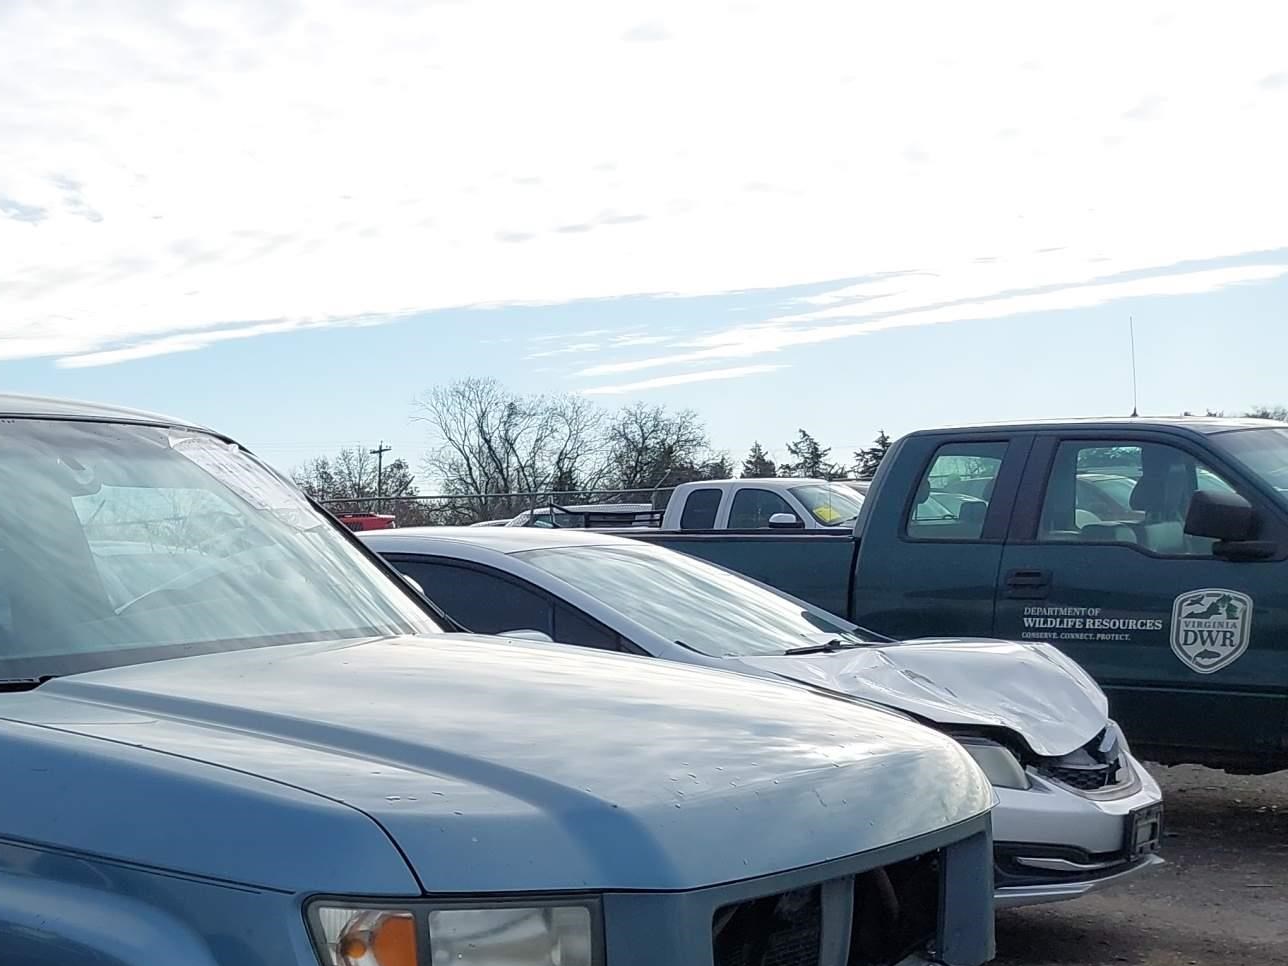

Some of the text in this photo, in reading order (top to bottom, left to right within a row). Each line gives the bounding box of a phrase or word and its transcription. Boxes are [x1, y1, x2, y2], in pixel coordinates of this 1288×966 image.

[1023, 607, 1102, 616] DEPARTMENT OF
[1023, 617, 1162, 630] WILDLIFE RESOURCES
[1183, 620, 1238, 629] VIRGINIA
[1182, 629, 1236, 647] DWR
